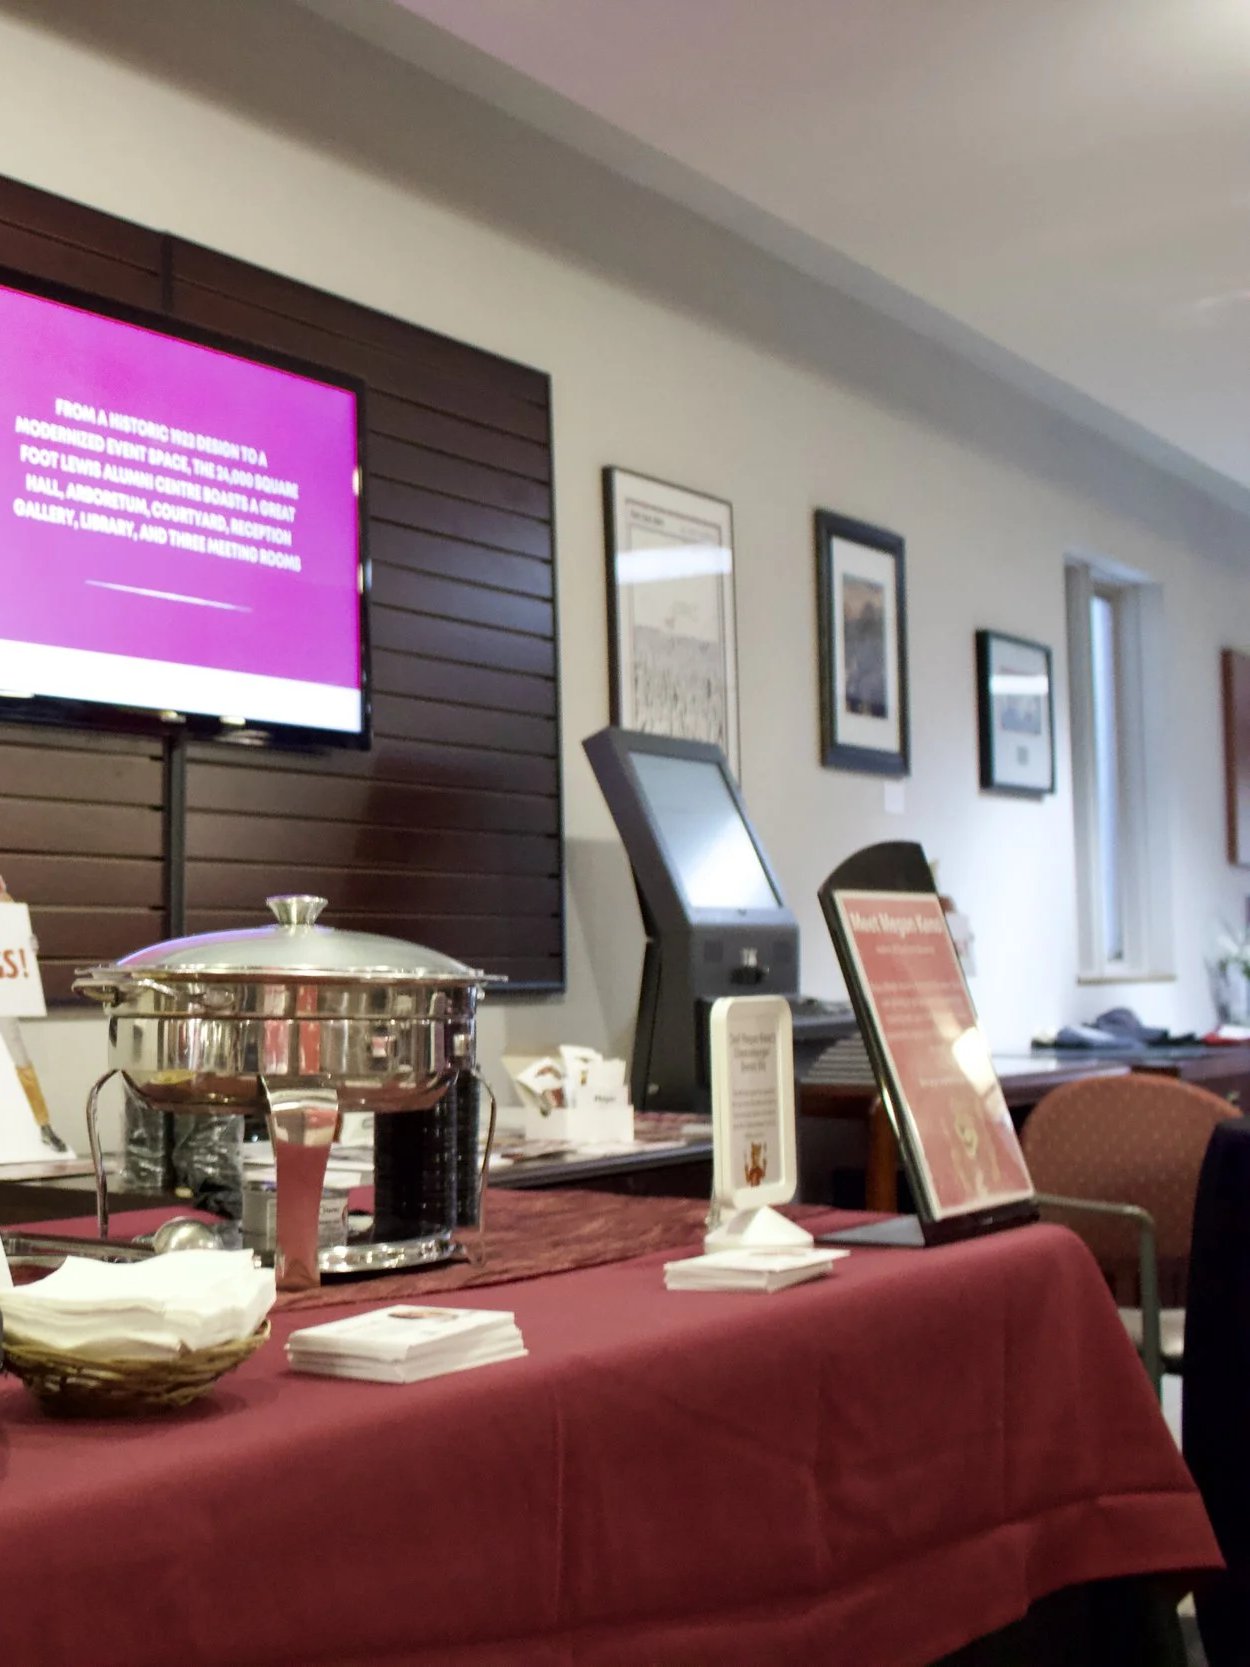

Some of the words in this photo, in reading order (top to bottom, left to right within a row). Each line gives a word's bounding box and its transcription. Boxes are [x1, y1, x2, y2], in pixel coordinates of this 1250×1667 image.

[15, 415, 105, 452] MODERNIZED
[106, 436, 147, 462] EVENT
[147, 447, 192, 476] SPACE,
[192, 457, 216, 480] THE
[254, 472, 299, 500] SQUARE
[55, 397, 96, 424] FROM
[97, 408, 109, 427] A
[109, 411, 169, 443] HISTORIC
[195, 433, 240, 460] DESIGN
[240, 445, 258, 465] TO
[258, 449, 268, 468] A
[20, 443, 59, 469] FOOT
[60, 452, 102, 479] LEWIS
[102, 463, 154, 491] ALUMNI
[155, 474, 202, 502] CENTRE
[202, 485, 249, 513] BOASTS
[249, 496, 260, 515] A
[259, 498, 297, 523] GREAT
[25, 472, 65, 500] HALL,
[66, 481, 151, 519] ARBORETUM,
[151, 500, 229, 536] COURTYARD,
[230, 517, 293, 547] RECEPTION
[12, 497, 79, 530] GALLERY,
[79, 511, 138, 542] LIBRARY,
[139, 523, 168, 545] AND
[168, 528, 207, 554] THREE
[207, 536, 259, 565] MEETING
[259, 547, 302, 573] ROOMS
